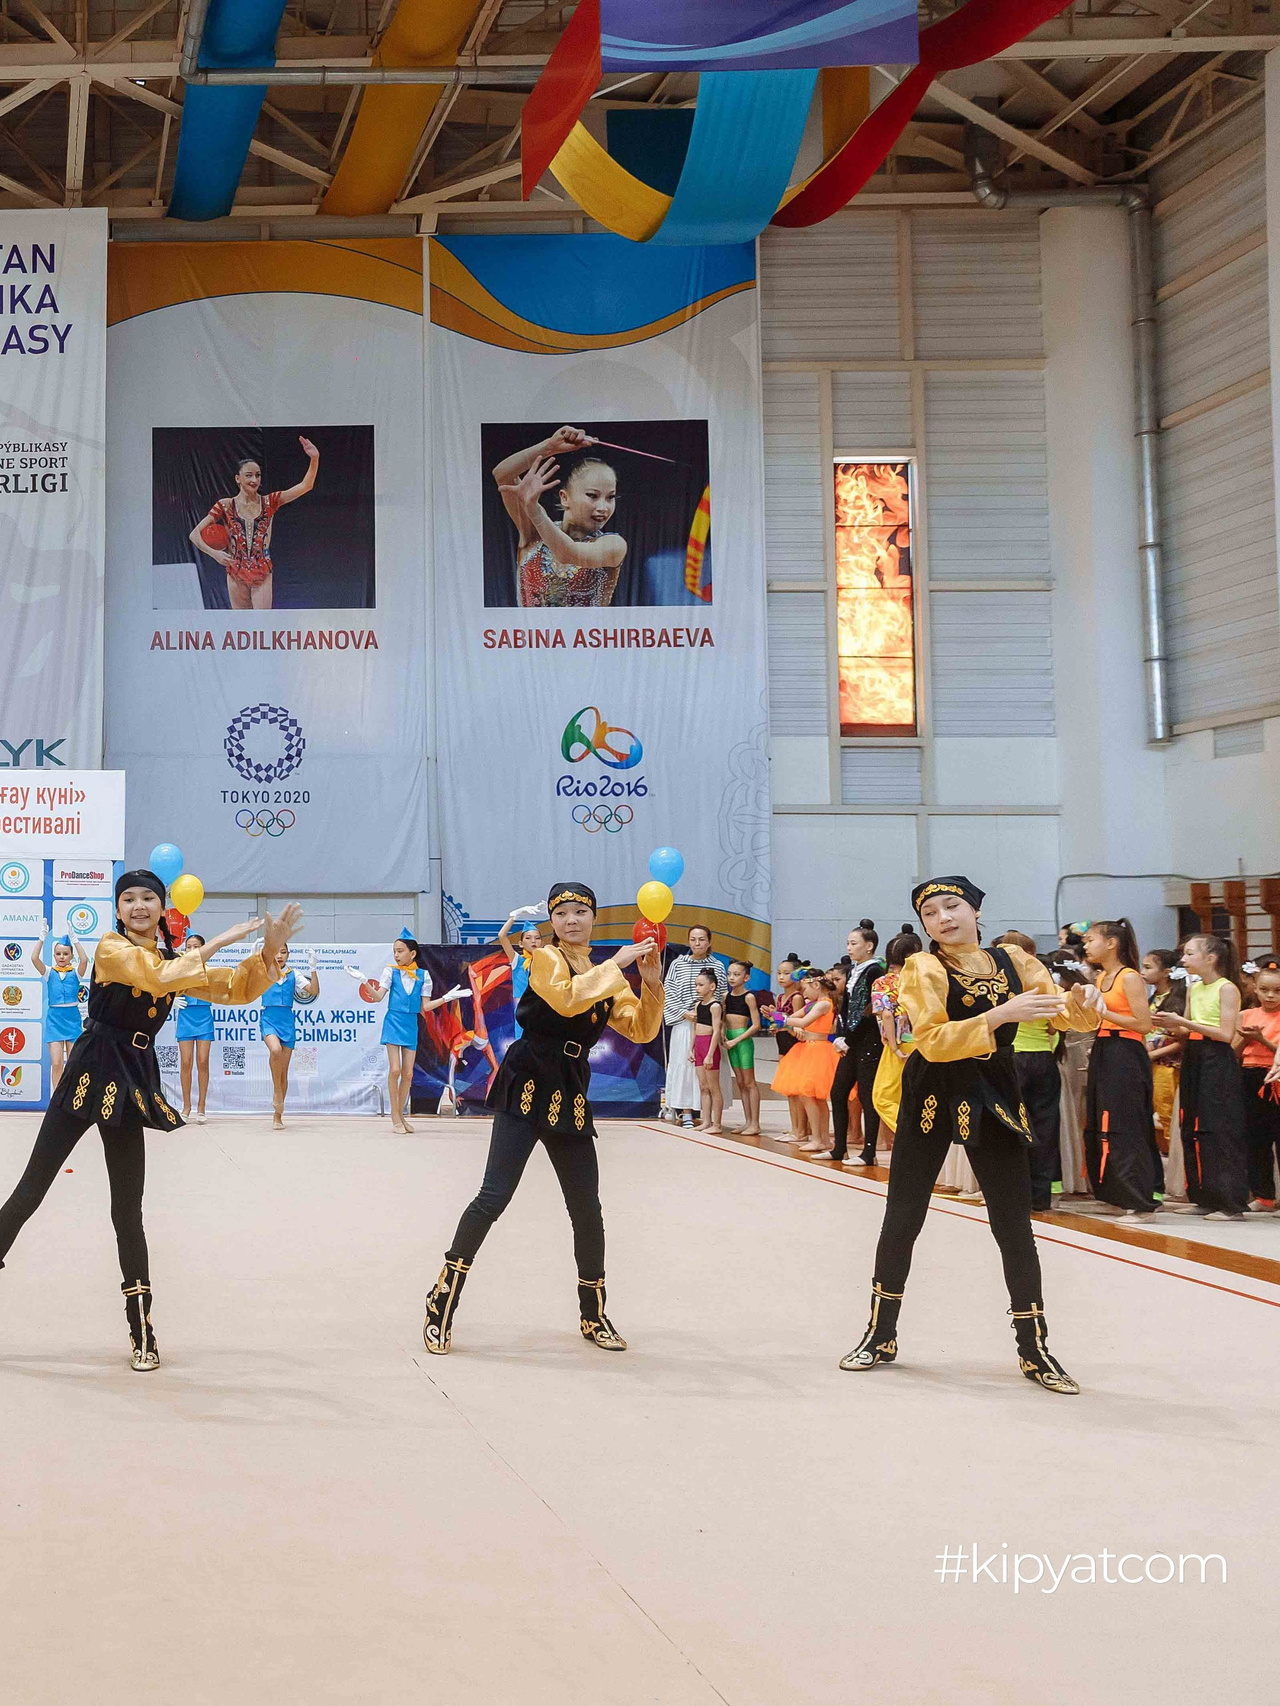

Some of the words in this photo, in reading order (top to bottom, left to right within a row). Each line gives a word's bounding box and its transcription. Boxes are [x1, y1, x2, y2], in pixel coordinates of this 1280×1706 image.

[19, 456, 68, 469] SPORT
[150, 631, 215, 651] ALINA
[221, 630, 379, 651] ADILKHANOVA
[483, 628, 565, 649] SABINA
[572, 627, 715, 649] ASHIRBAEVA
[35, 781, 86, 811] күні»
[220, 790, 270, 804] TOKYO
[274, 790, 311, 804] 2020
[61, 871, 104, 880] ProDanceShop
[330, 1010, 376, 1024] ЖӘНЕ
